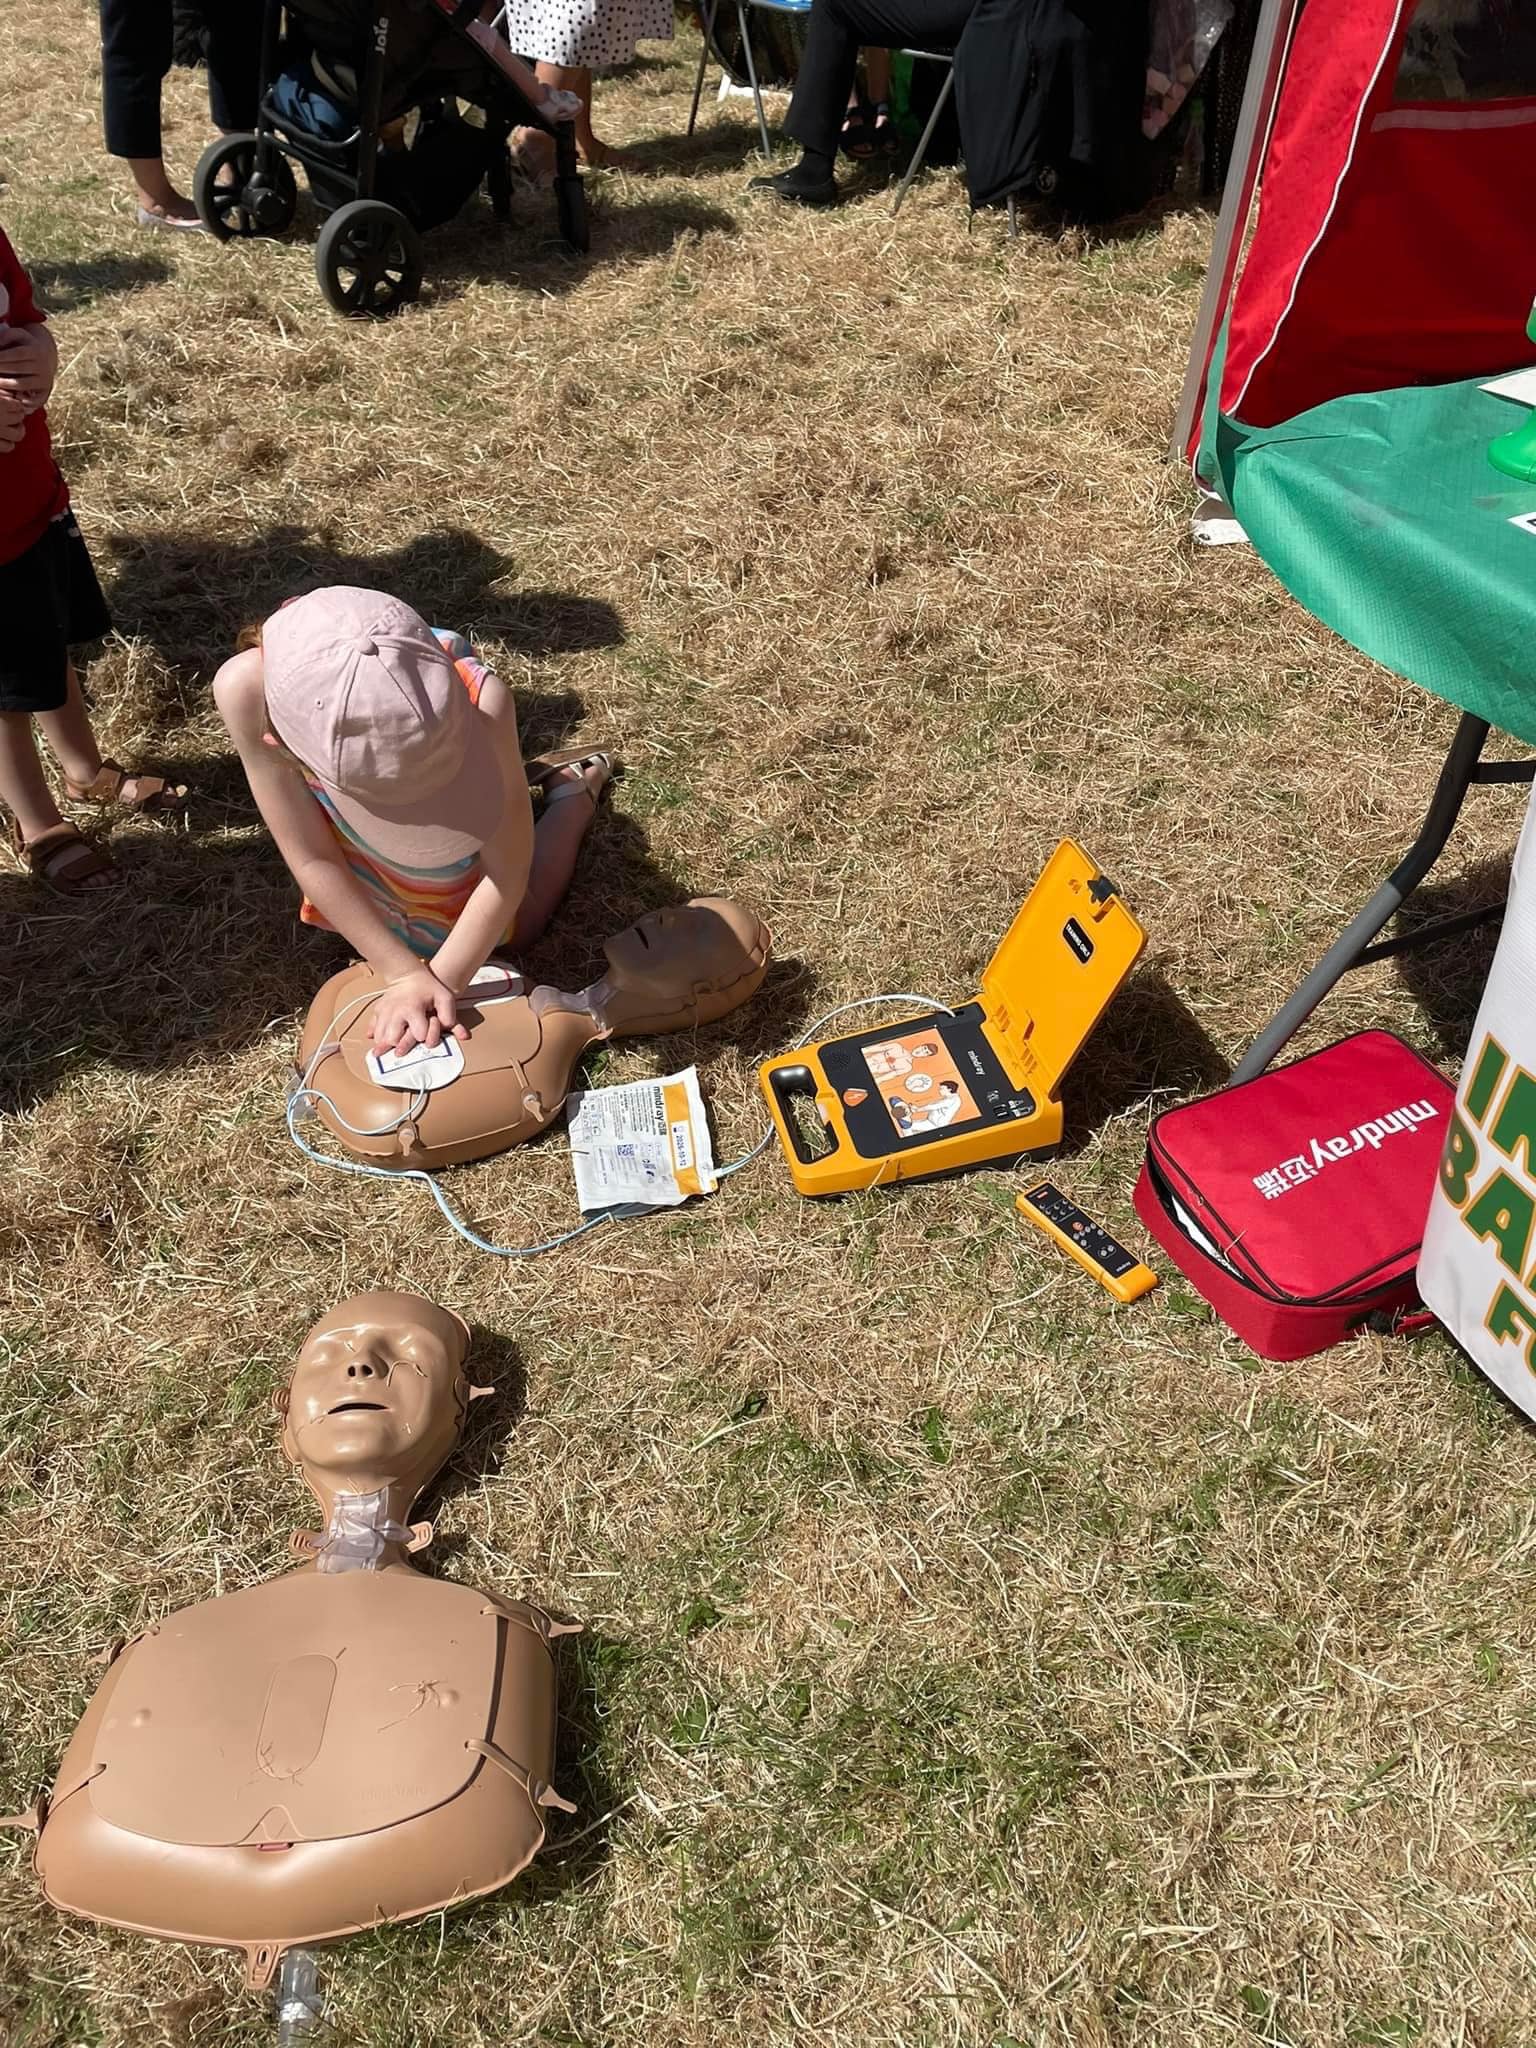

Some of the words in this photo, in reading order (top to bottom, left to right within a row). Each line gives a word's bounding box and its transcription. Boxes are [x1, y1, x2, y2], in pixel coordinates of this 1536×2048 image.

[373, 16, 389, 56] Joie
[653, 1086, 665, 1121] mindray
[1310, 1098, 1440, 1168] mindray
[1251, 1154, 1319, 1201] 迈瑞
[1439, 1107, 1536, 1297] BA
